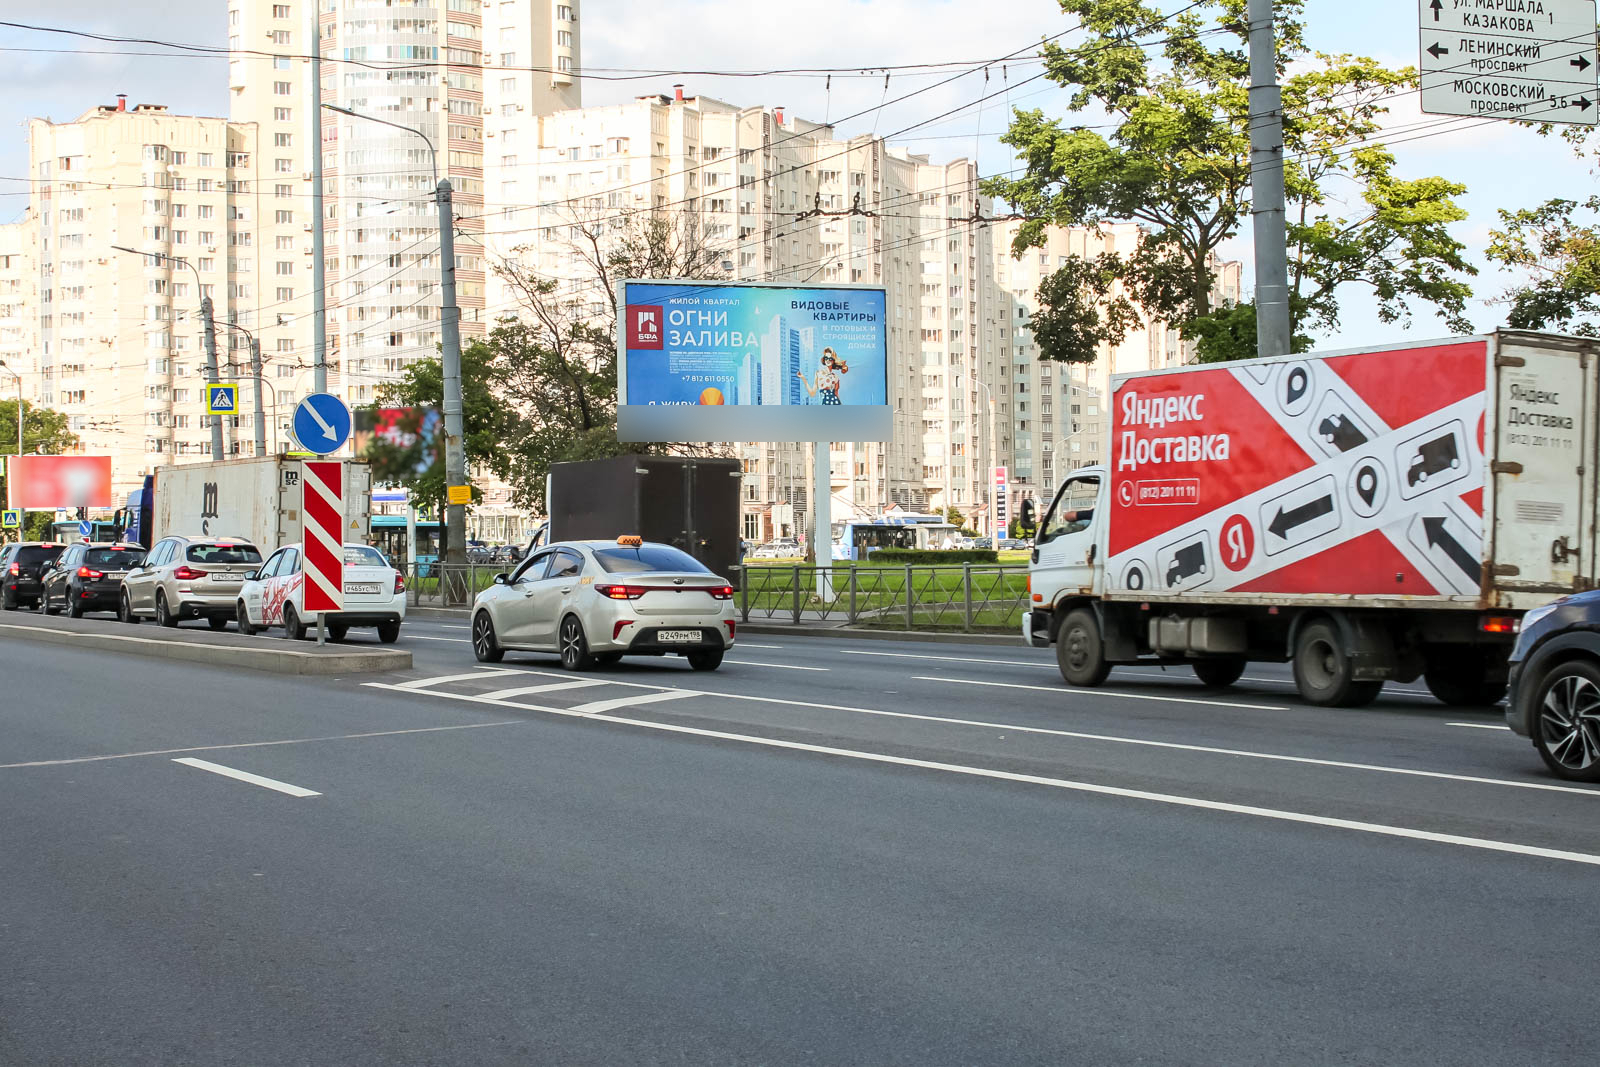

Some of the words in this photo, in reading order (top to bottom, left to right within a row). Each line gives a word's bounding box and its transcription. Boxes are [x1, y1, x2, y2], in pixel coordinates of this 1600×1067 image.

[1475, 0, 1544, 15] МАРШАЛА
[1463, 12, 1534, 32] КАЗАКОВА
[1548, 12, 1553, 25] 1
[1459, 39, 1541, 59] ЛЕНИНСКИЙ
[1471, 58, 1528, 72] проспект
[1453, 80, 1545, 99] МОСКОВСКИЙ
[1470, 99, 1528, 113] проспект
[669, 297, 700, 305] ЖИЛОЙ
[703, 298, 740, 306] КВАРТАЛ
[791, 300, 850, 311] ВИДОВЫЕ
[669, 309, 728, 326] ОГНИ
[813, 312, 876, 322] КВАРТИРЫ
[668, 330, 759, 347] ЗАЛИВА
[822, 333, 876, 341] СТРОЯЩИХСЯ
[848, 342, 876, 350] ДОМАХ
[1510, 383, 1559, 405] Яндекс
[1122, 391, 1204, 429] Яндекс
[1507, 406, 1573, 429] Доставка
[1118, 431, 1230, 472] Доставка
[1227, 522, 1247, 563] Я
